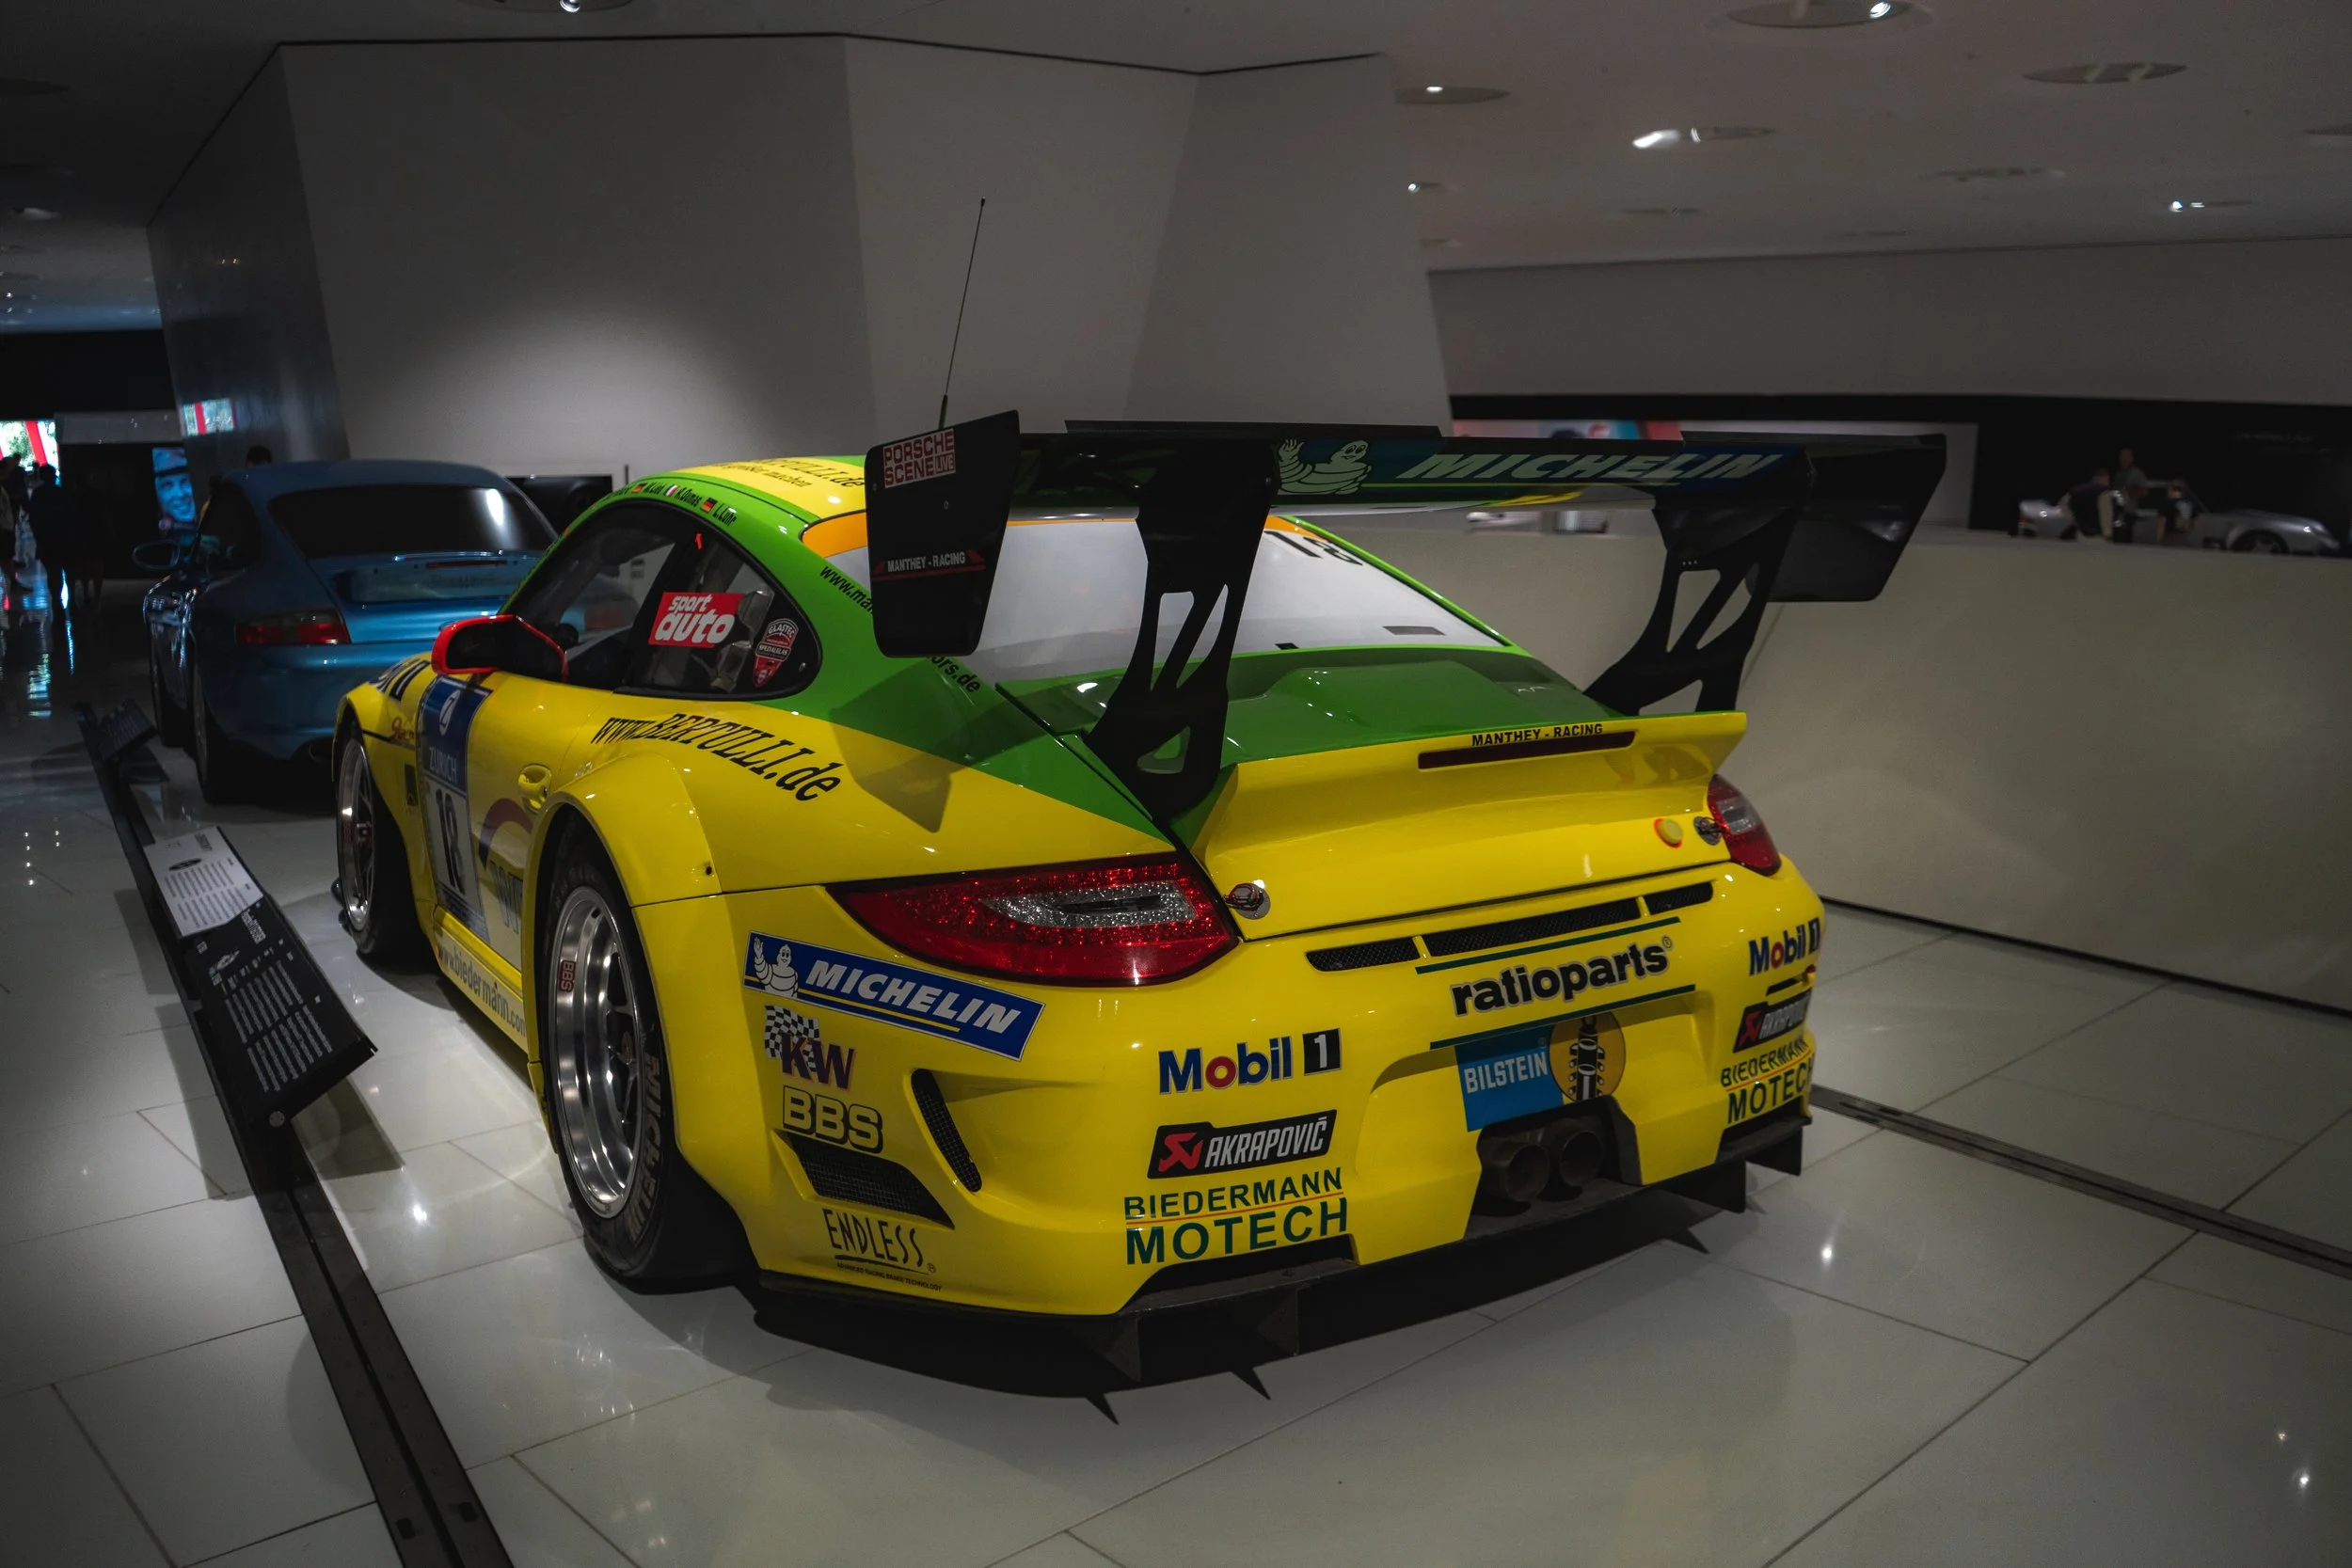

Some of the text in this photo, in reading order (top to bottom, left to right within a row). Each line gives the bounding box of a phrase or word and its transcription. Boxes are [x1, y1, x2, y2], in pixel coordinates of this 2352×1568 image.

[884, 431, 954, 466] PORSCHE
[885, 454, 955, 485] SCENE LIVE
[1395, 453, 1784, 481] MICHELIN
[888, 556, 926, 573] MANTHEY
[933, 550, 965, 566] RACING
[1263, 531, 1362, 565] 18
[655, 609, 736, 643] auto
[668, 594, 713, 613] sport
[768, 624, 795, 639] GLASTEC
[1472, 728, 1541, 746] MANTHEY
[1553, 723, 1603, 738] RACING
[1749, 925, 1805, 976] Mobil
[560, 960, 576, 991] BBS
[806, 959, 1022, 1034] MICHELIN
[1453, 943, 1668, 1016] ratioparts
[782, 1034, 855, 1089] KW
[1158, 1036, 1293, 1094] Mobil
[1463, 1052, 1549, 1094] BILSTEIN
[1721, 1037, 1810, 1087] BIEDERMANN
[783, 1085, 882, 1153] BBS
[1204, 1117, 1328, 1168] AKRAPOVIČ
[1124, 1167, 1342, 1219] BIEDERMANN
[822, 1209, 922, 1266] ENDLESS
[1126, 1197, 1347, 1264] MOTECH
